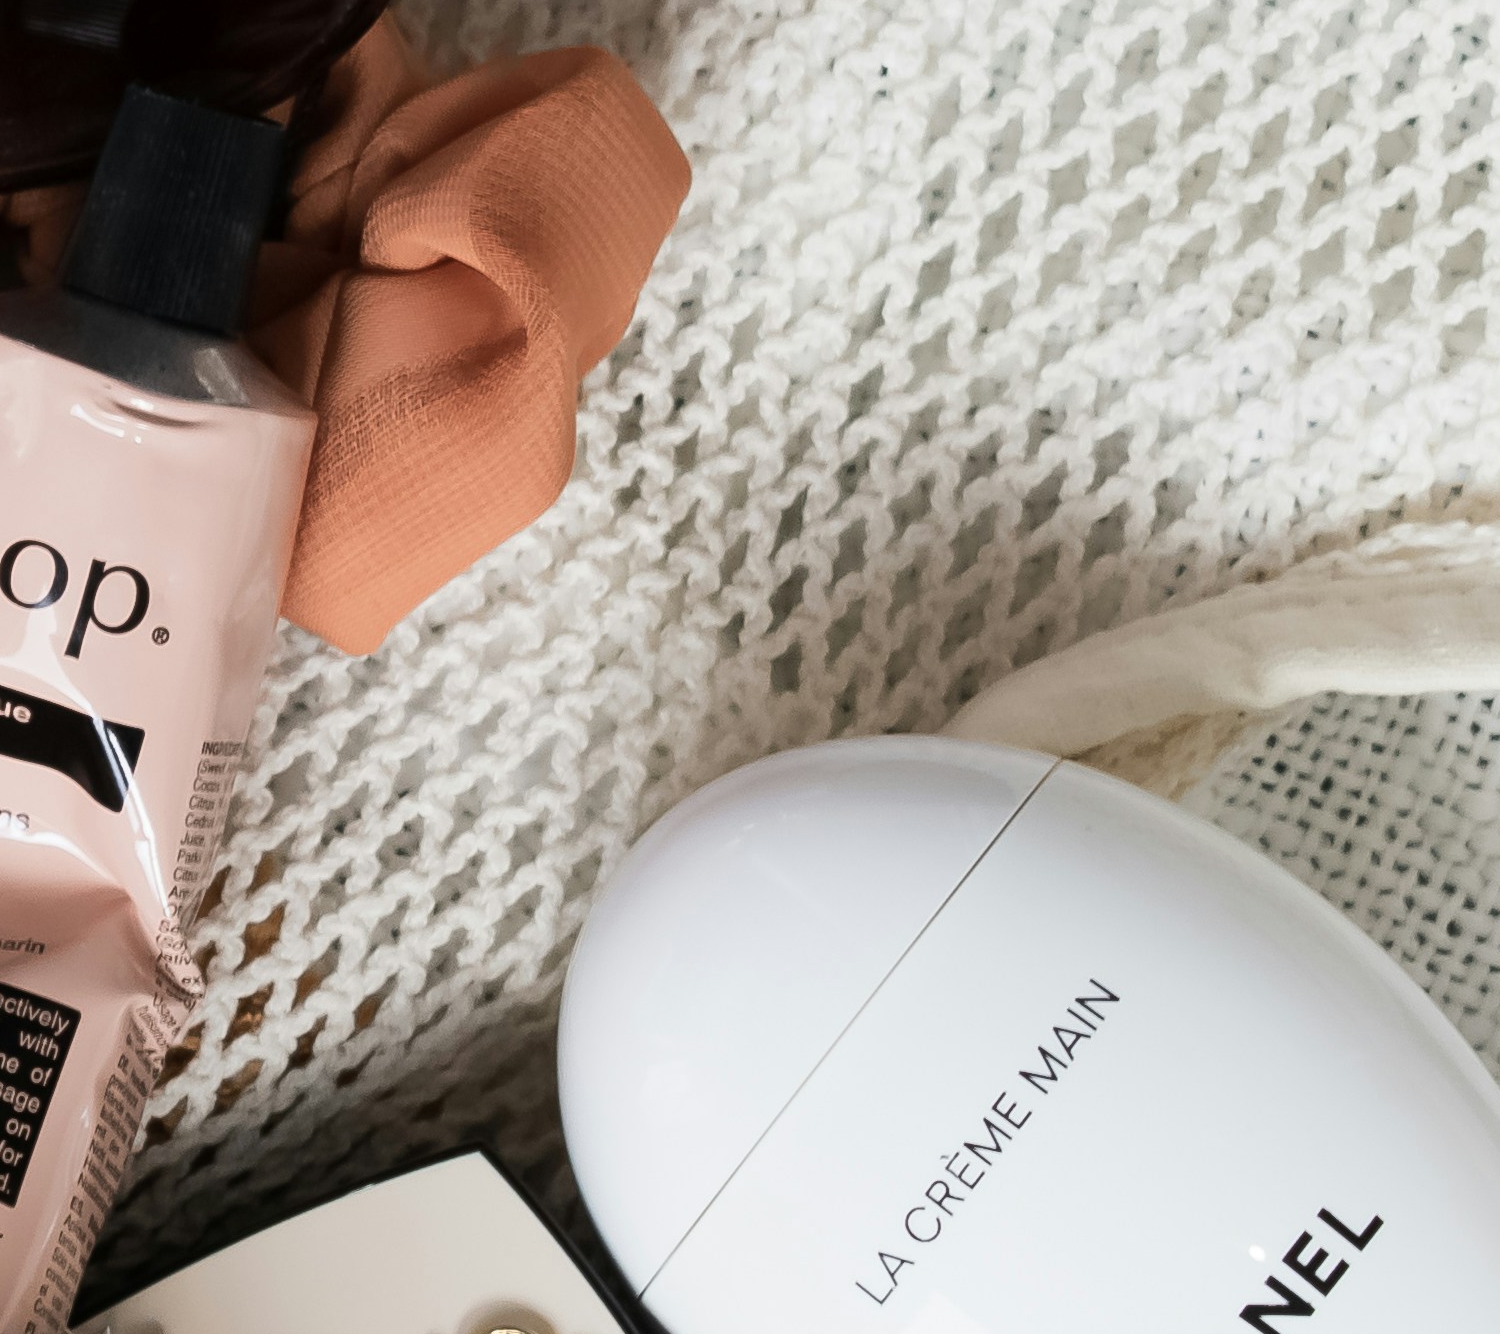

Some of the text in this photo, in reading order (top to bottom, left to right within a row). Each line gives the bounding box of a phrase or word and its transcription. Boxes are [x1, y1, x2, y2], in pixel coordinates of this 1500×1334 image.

[19, 1027, 61, 1062] with
[29, 1066, 54, 1088] of
[4, 1116, 32, 1143] on
[852, 976, 1123, 1308] LA CRÈME MAIN
